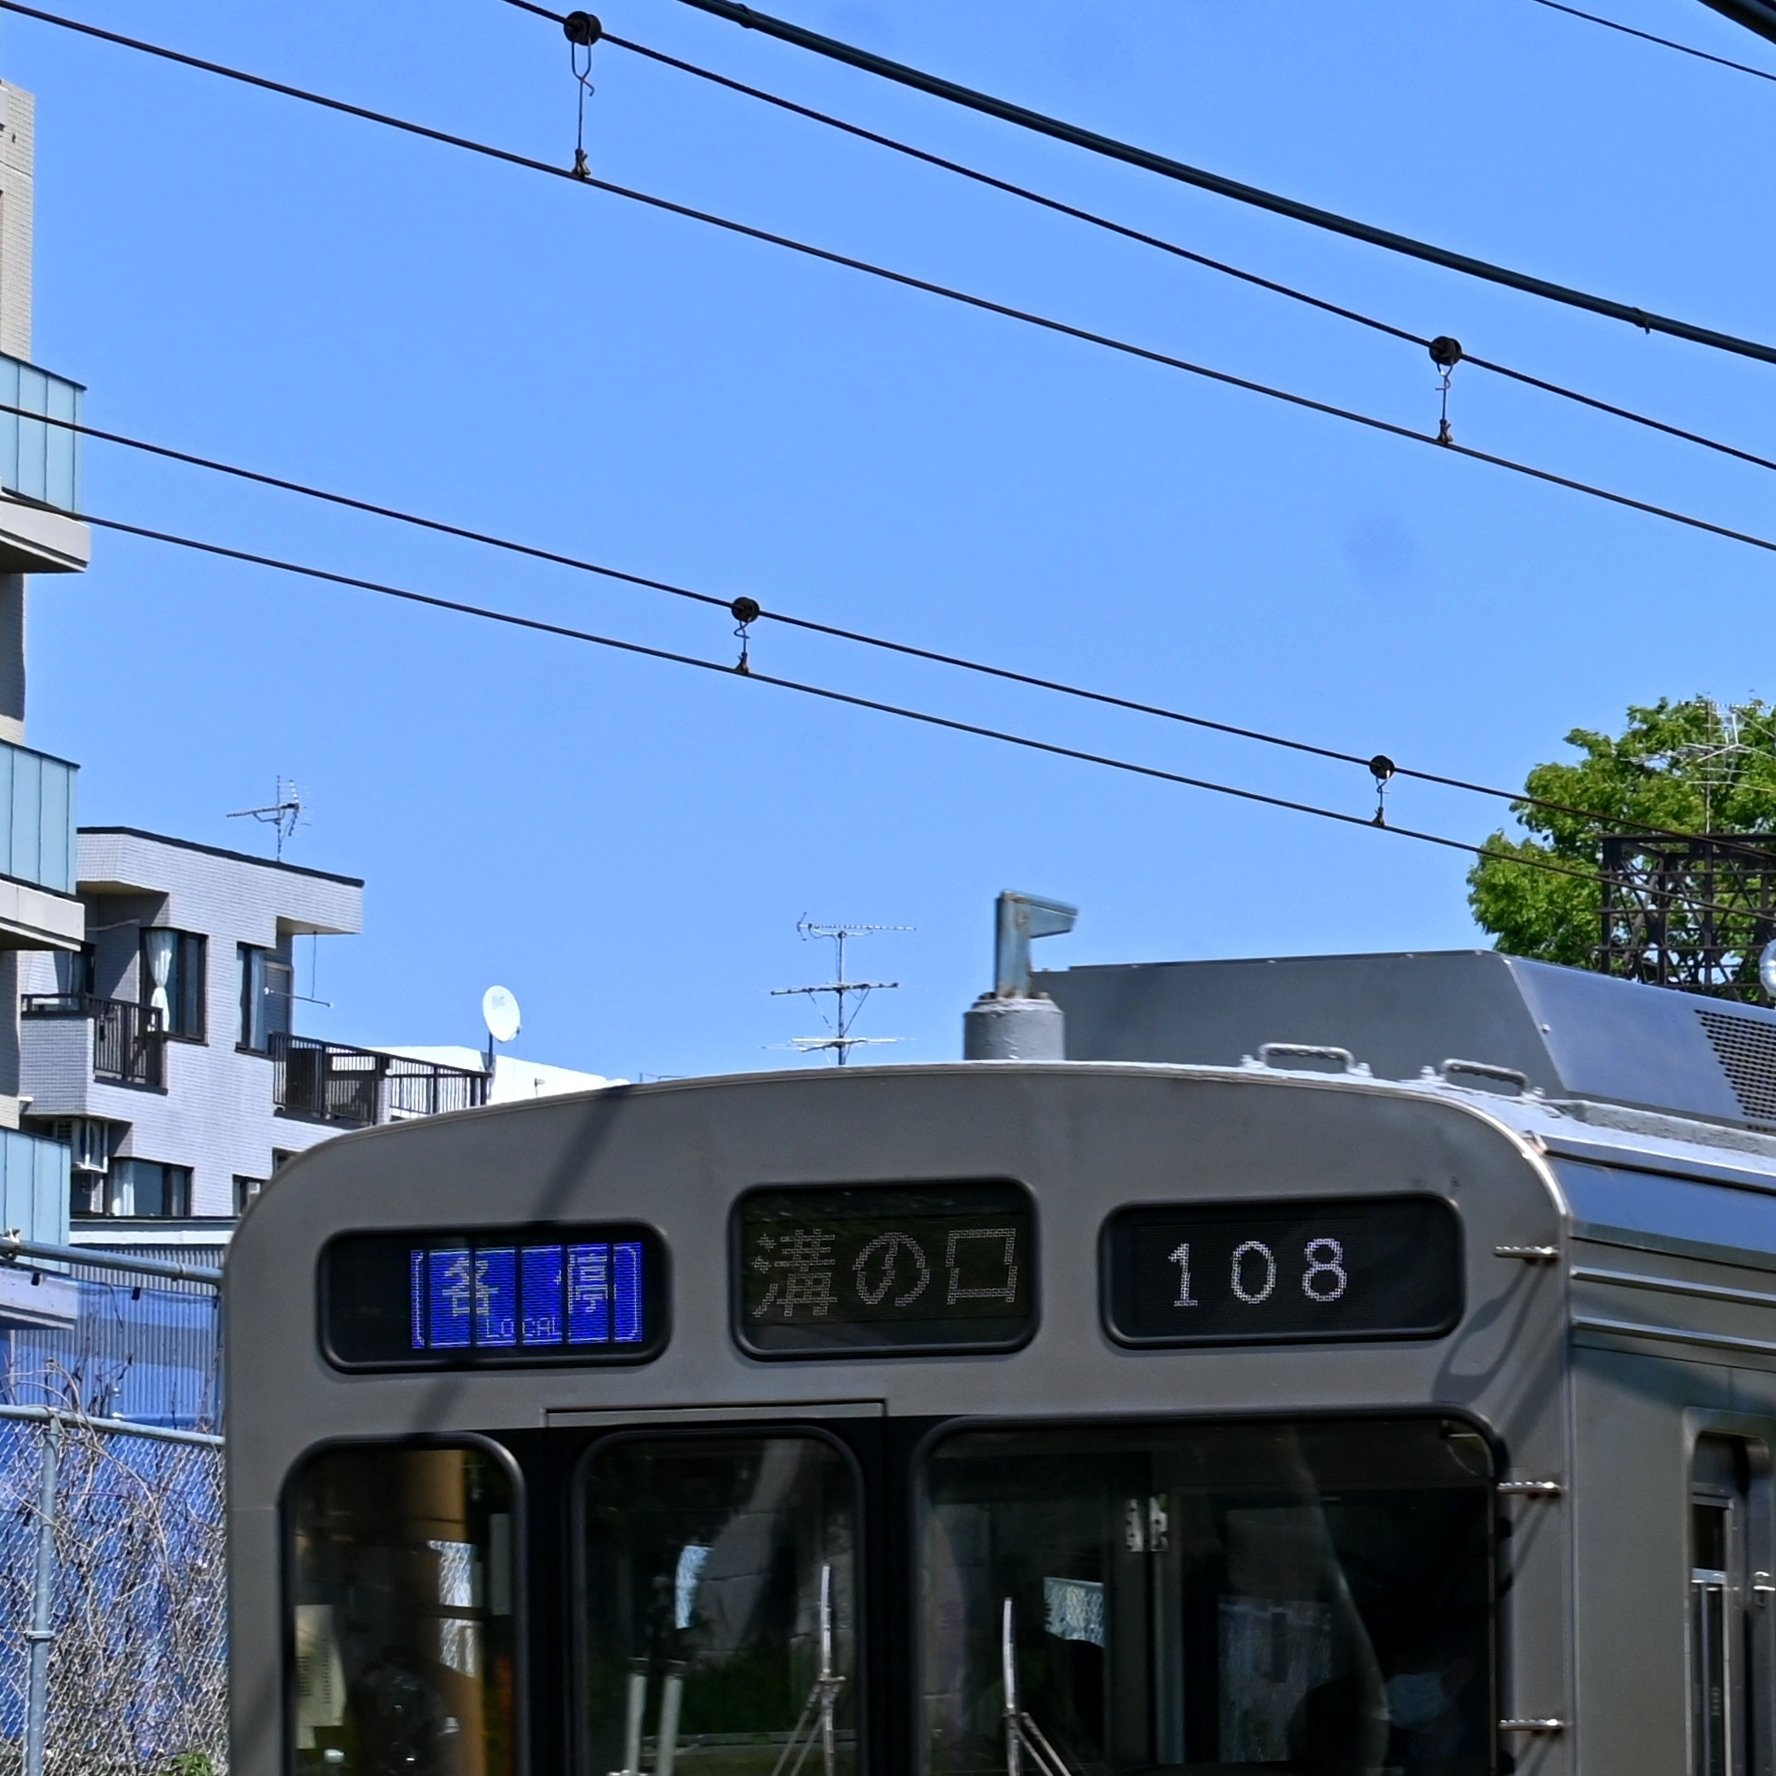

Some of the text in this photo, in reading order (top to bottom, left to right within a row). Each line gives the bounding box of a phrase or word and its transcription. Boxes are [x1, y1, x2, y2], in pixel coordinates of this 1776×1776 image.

[751, 1228, 1018, 1318] 溝の口
[1168, 1238, 1348, 1307] 108
